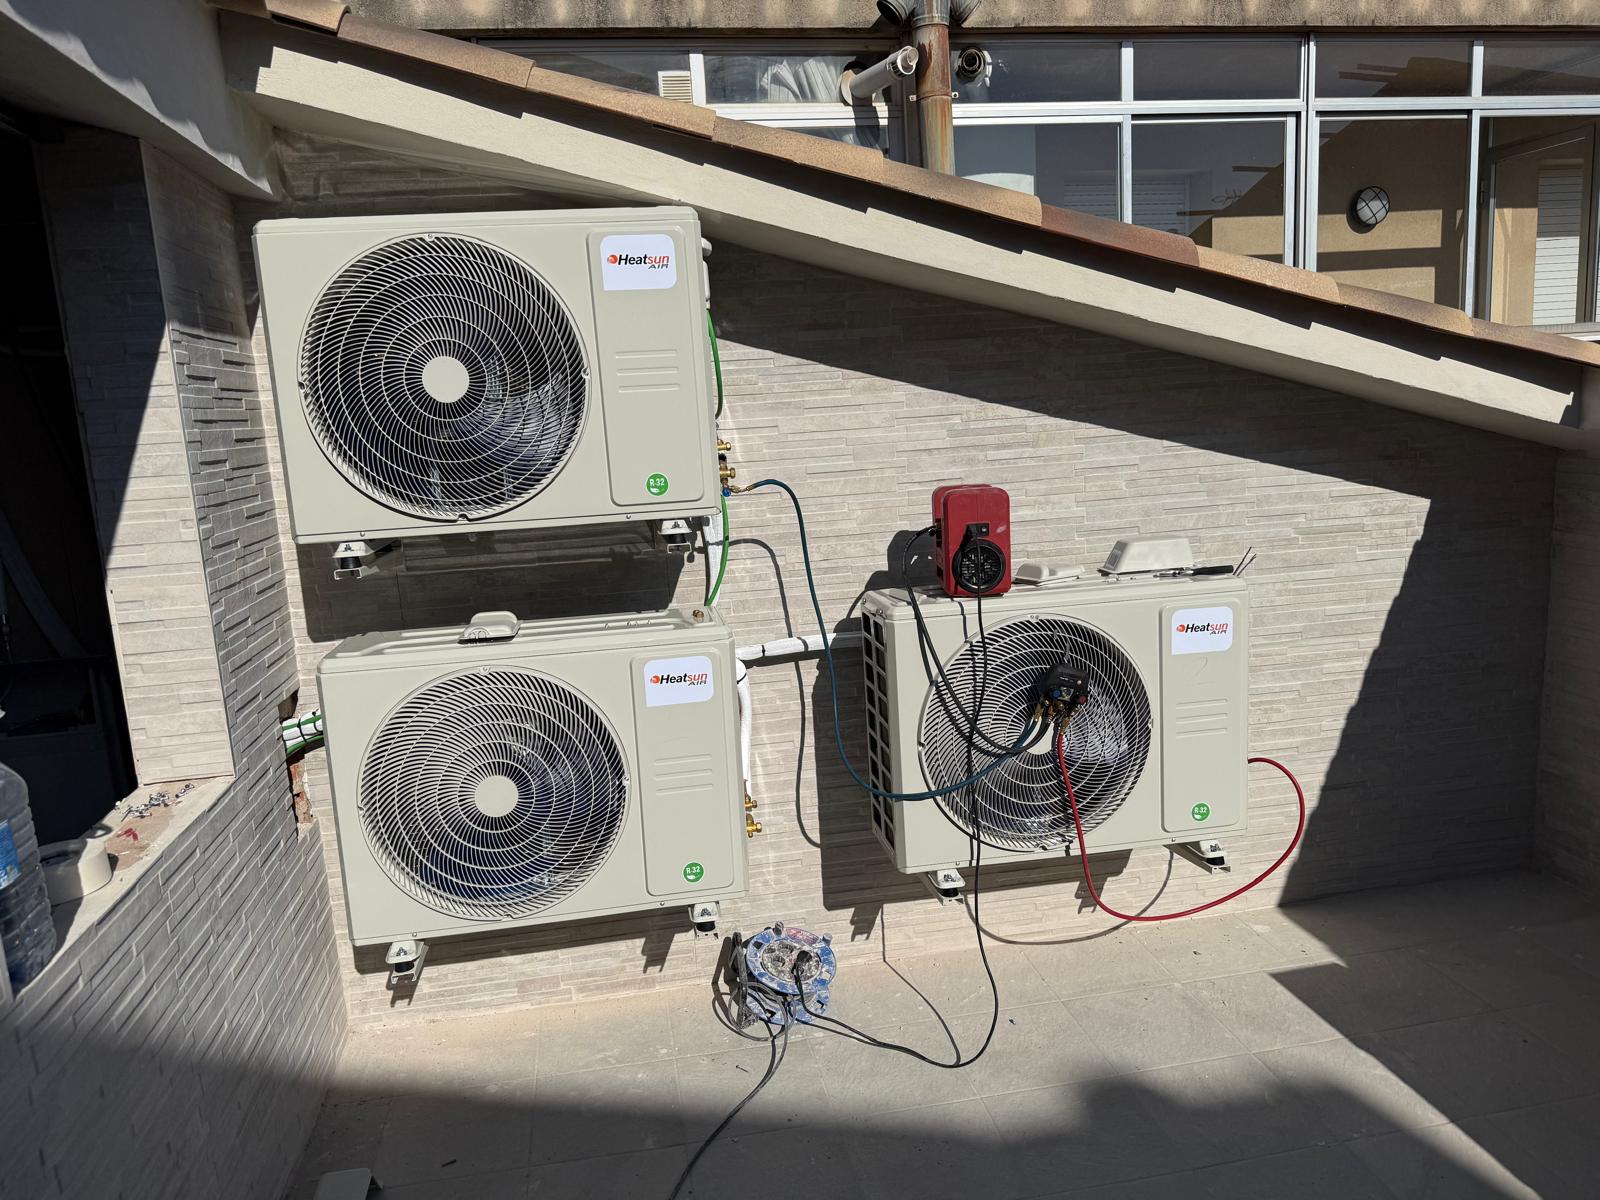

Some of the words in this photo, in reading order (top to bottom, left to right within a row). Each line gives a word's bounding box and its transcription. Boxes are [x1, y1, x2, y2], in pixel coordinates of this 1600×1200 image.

[618, 254, 669, 265] Heatsun
[1185, 623, 1228, 633] Heatsun
[660, 673, 708, 684] Heatsun
